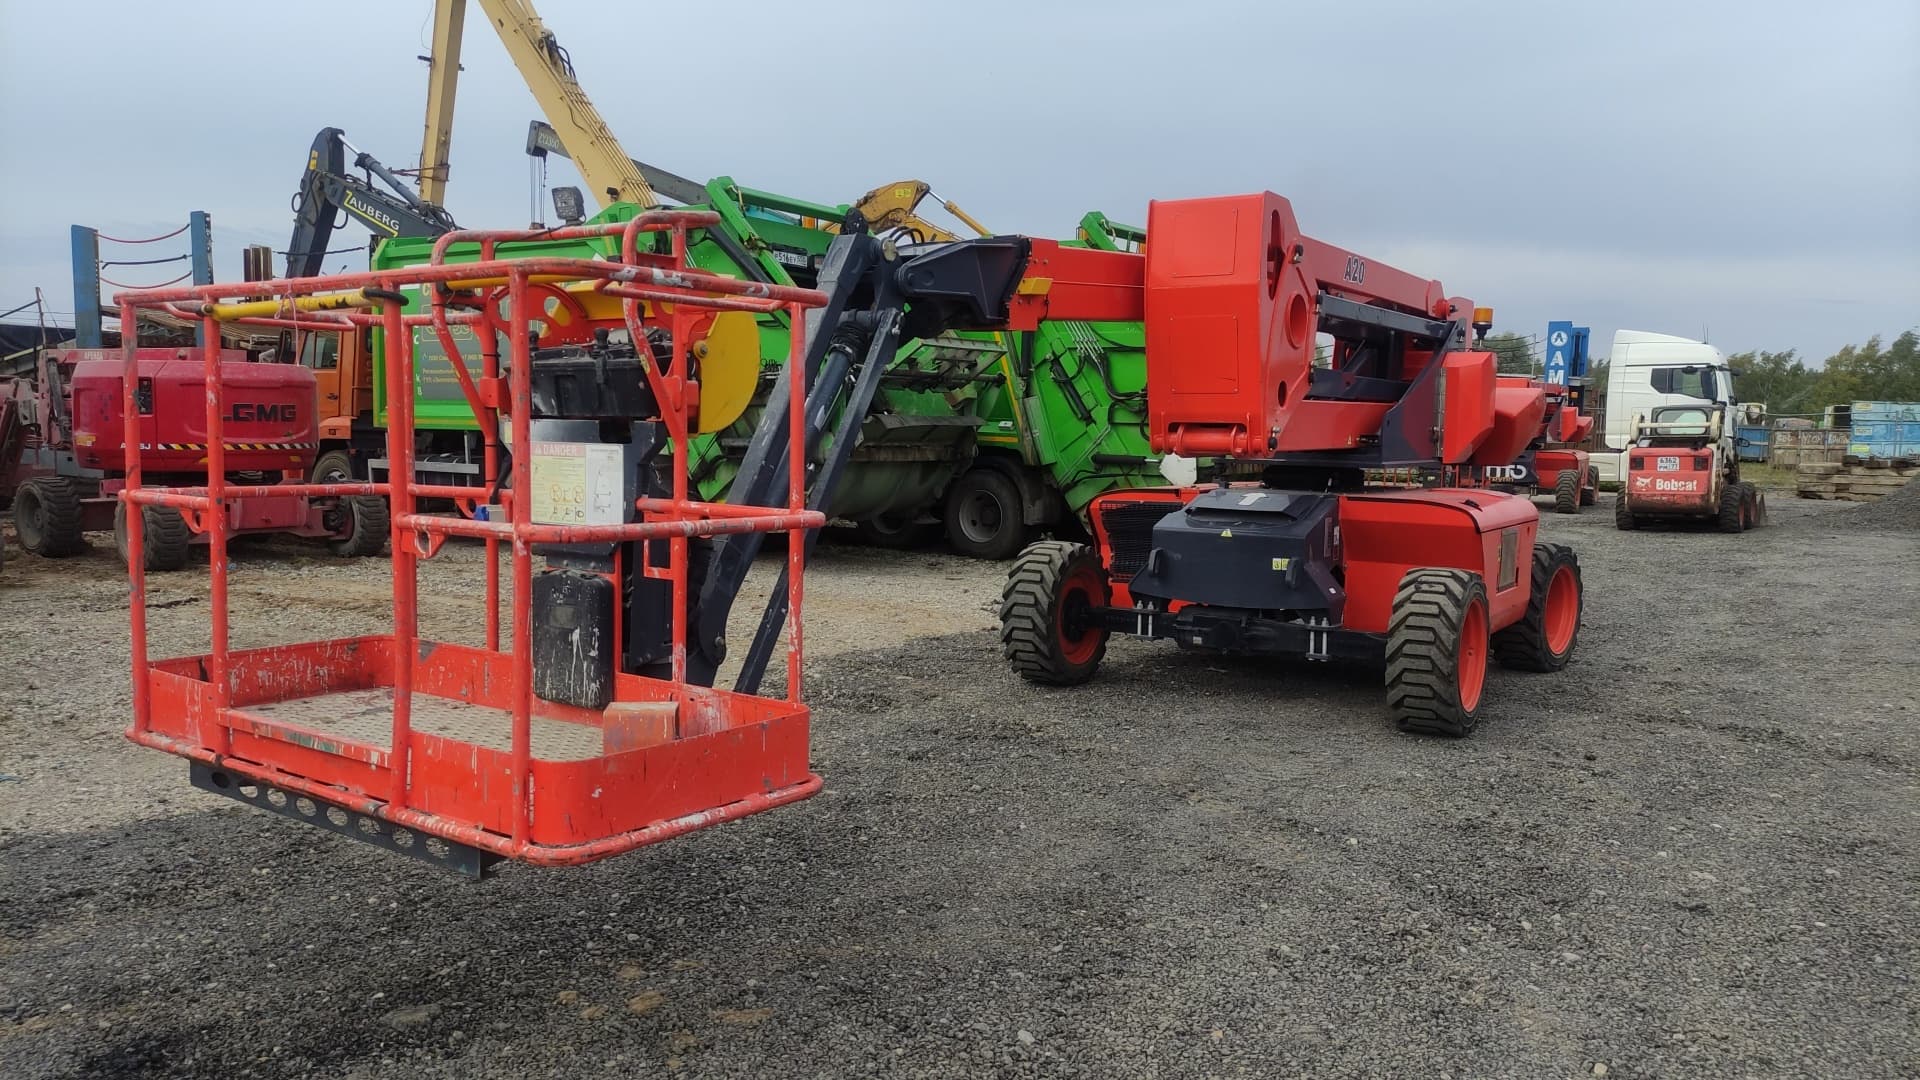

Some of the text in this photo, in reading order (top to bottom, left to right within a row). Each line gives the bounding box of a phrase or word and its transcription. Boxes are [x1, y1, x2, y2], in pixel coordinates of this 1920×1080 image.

[344, 190, 400, 231] ZAUBERG
[1344, 256, 1365, 285] A20
[544, 444, 577, 457] DANGER
[1656, 479, 1697, 491] Bobcat
